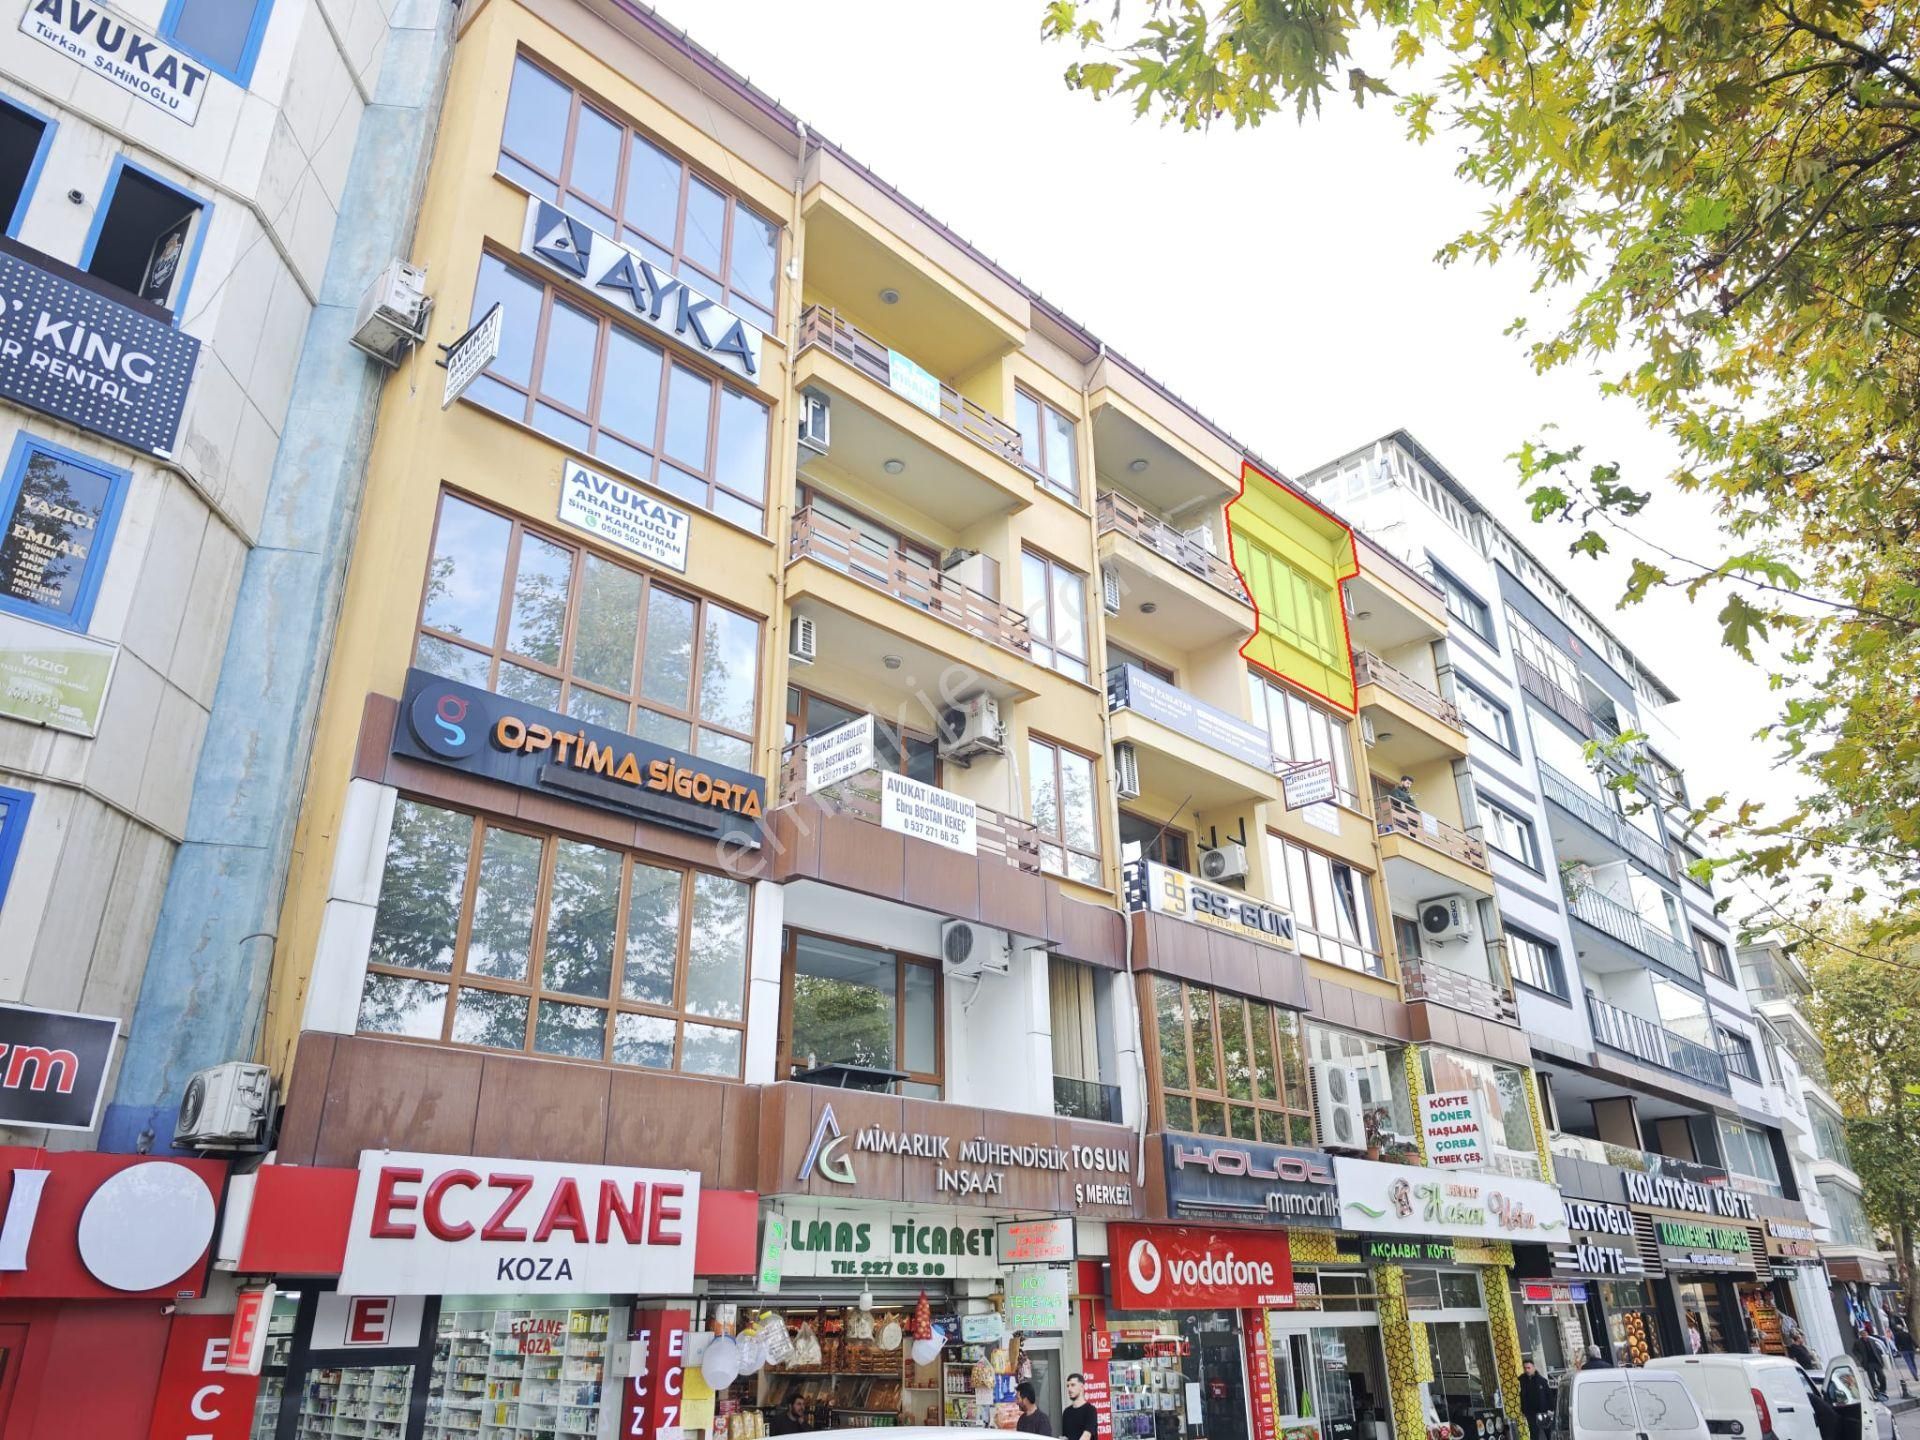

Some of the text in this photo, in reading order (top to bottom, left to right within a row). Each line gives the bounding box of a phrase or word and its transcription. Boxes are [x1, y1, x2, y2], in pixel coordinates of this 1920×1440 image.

[35, 0, 205, 97] AVUKAT
[36, 21, 87, 59] Türkan
[595, 252, 756, 376] AYKA
[30, 350, 133, 406] RENTAL
[23, 494, 95, 530] YAZICI
[572, 470, 683, 529] AVUKAT
[575, 489, 676, 540] ARABULUCU
[12, 524, 87, 559] EMLAK
[568, 499, 681, 554] Sinan KARADUMAN
[22, 655, 69, 675] YAZICI
[811, 722, 867, 756] AVUKAT ARABULUCU
[496, 715, 762, 818] OPTİMA SİGORTA
[888, 778, 975, 819] AVUKAT ARABULUCU
[896, 799, 913, 815] Ebru
[914, 805, 943, 825] BOSTAN
[911, 821, 924, 834] 537
[925, 826, 938, 838] 271
[950, 834, 959, 845] 25
[1430, 1096, 1468, 1109] KÖFTE
[1431, 1110, 1472, 1123] DÖNER
[855, 1123, 1070, 1172] MİMARLIK MÜHENDİSLİK
[1428, 1123, 1479, 1137] HAŞLAMA
[1436, 1138, 1476, 1152] ÇORBA
[1071, 1144, 1130, 1173] TOSUN
[1432, 1154, 1462, 1165] YEMEK
[936, 1161, 1004, 1196] İNŞAAT
[1086, 1182, 1133, 1206] MERKEZİ
[1625, 1172, 1757, 1220] KOLOTOĞLU KÖFTE
[370, 1166, 685, 1246] ECZANE
[785, 1218, 994, 1257] LMAS TİCARET
[1371, 1242, 1421, 1261] AKÇAABAT
[1576, 1236, 1626, 1274] KÖFTE
[497, 1257, 573, 1281] KOZA
[861, 1261, 893, 1275] 227
[897, 1262, 918, 1275] 03
[923, 1262, 945, 1276] 00
[1167, 1252, 1274, 1286] vodafone
[351, 1299, 388, 1341] E
[511, 1319, 564, 1337] ECZANE
[518, 1336, 551, 1354] KOZA
